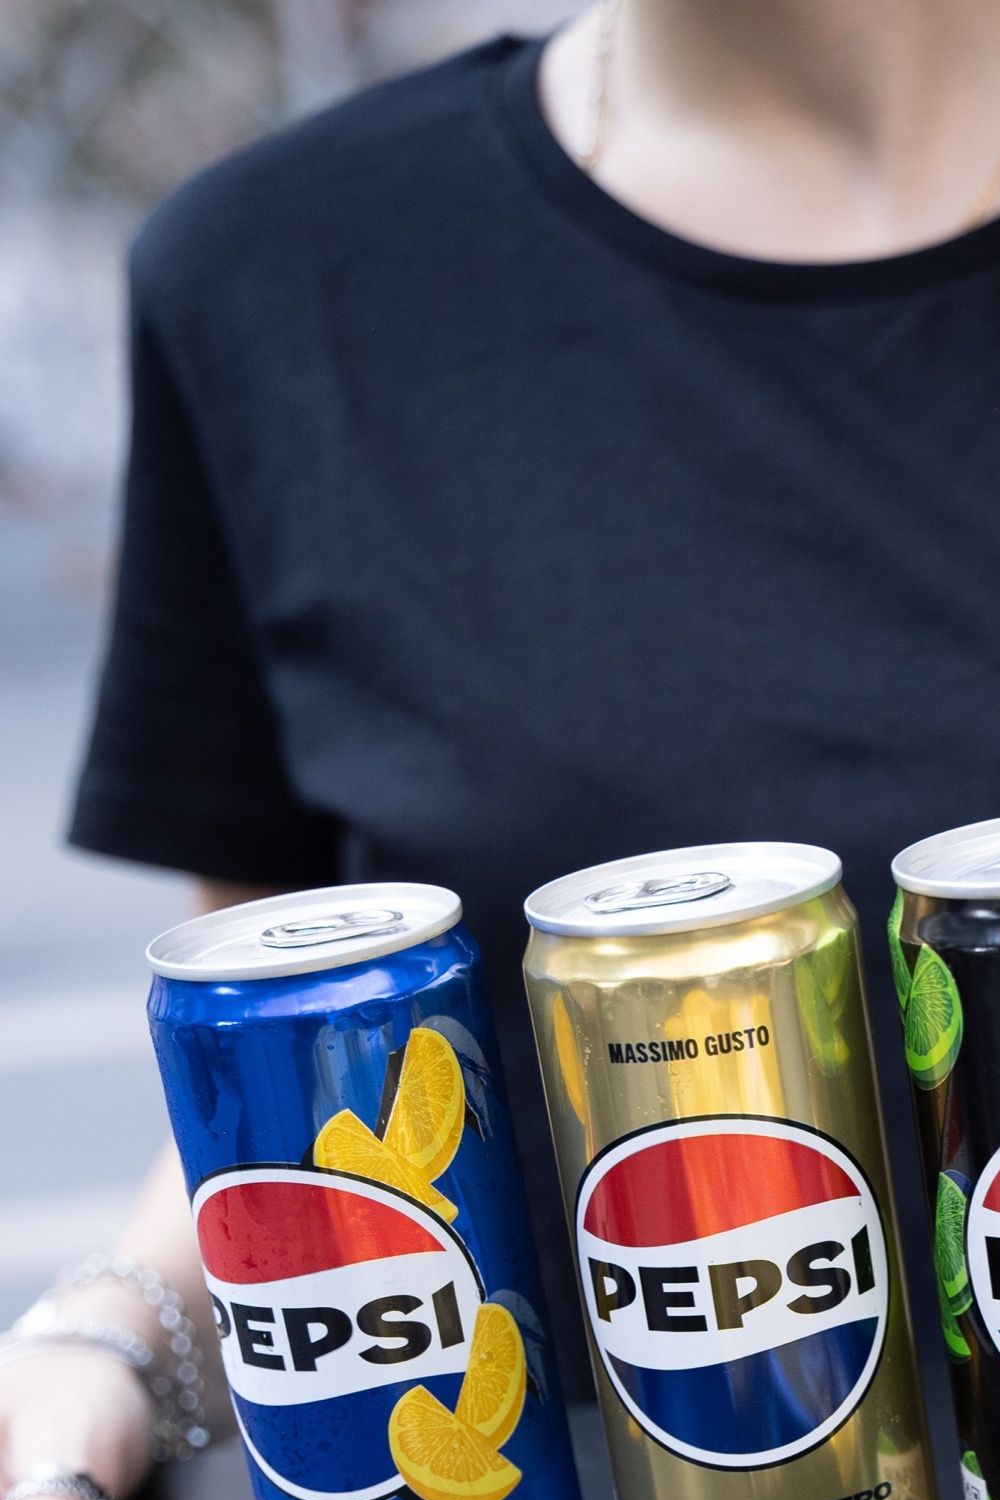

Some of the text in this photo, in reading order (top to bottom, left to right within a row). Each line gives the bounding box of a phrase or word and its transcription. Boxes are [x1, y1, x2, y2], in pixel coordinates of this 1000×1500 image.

[607, 1024, 770, 1064] MASSIMO GUSTO
[587, 1223, 877, 1333] PEPSI
